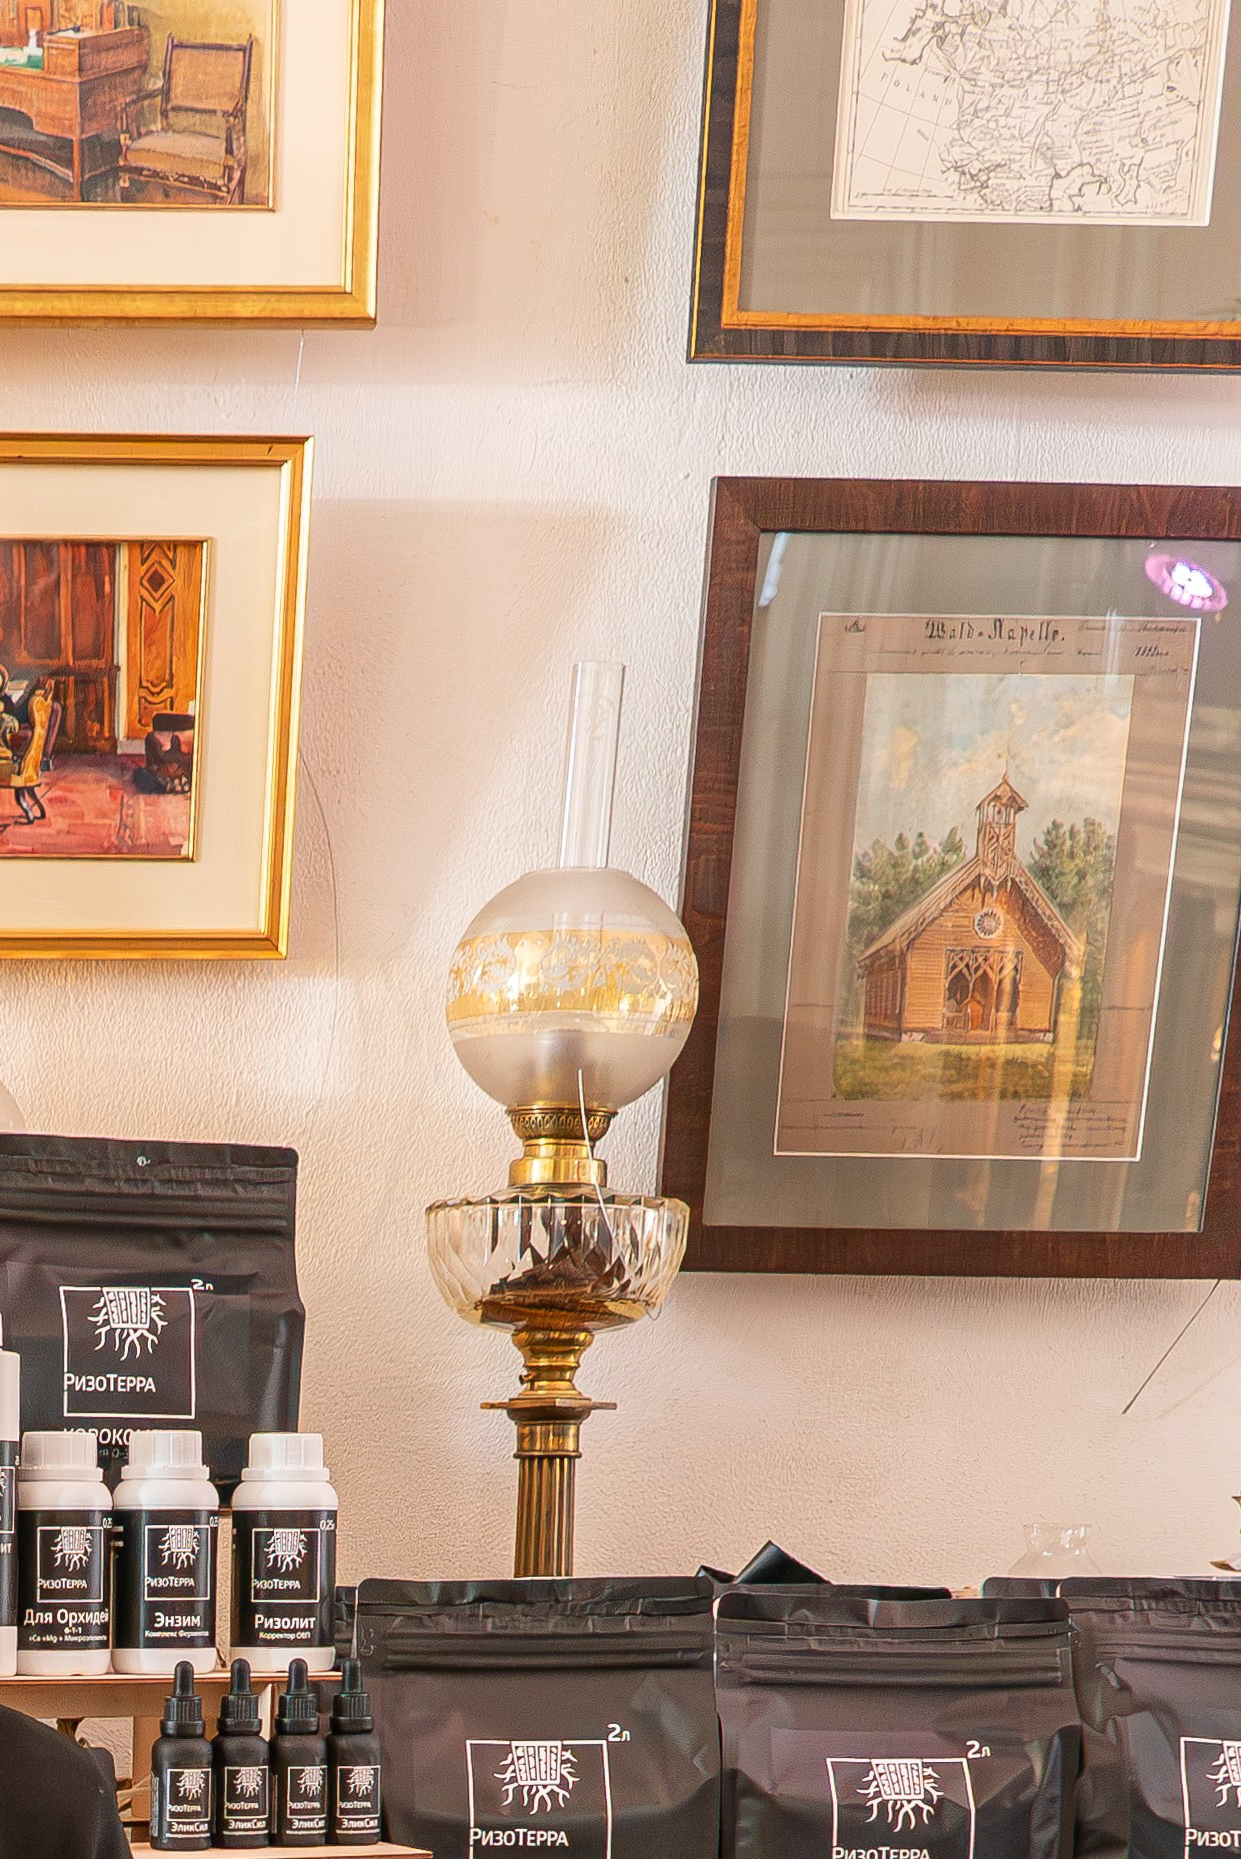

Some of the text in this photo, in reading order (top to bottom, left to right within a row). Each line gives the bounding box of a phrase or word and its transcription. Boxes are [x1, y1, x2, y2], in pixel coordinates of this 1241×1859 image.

[23, 1608, 53, 1626] Для
[154, 1611, 201, 1628] Энзим
[254, 1614, 316, 1629] Ризолит
